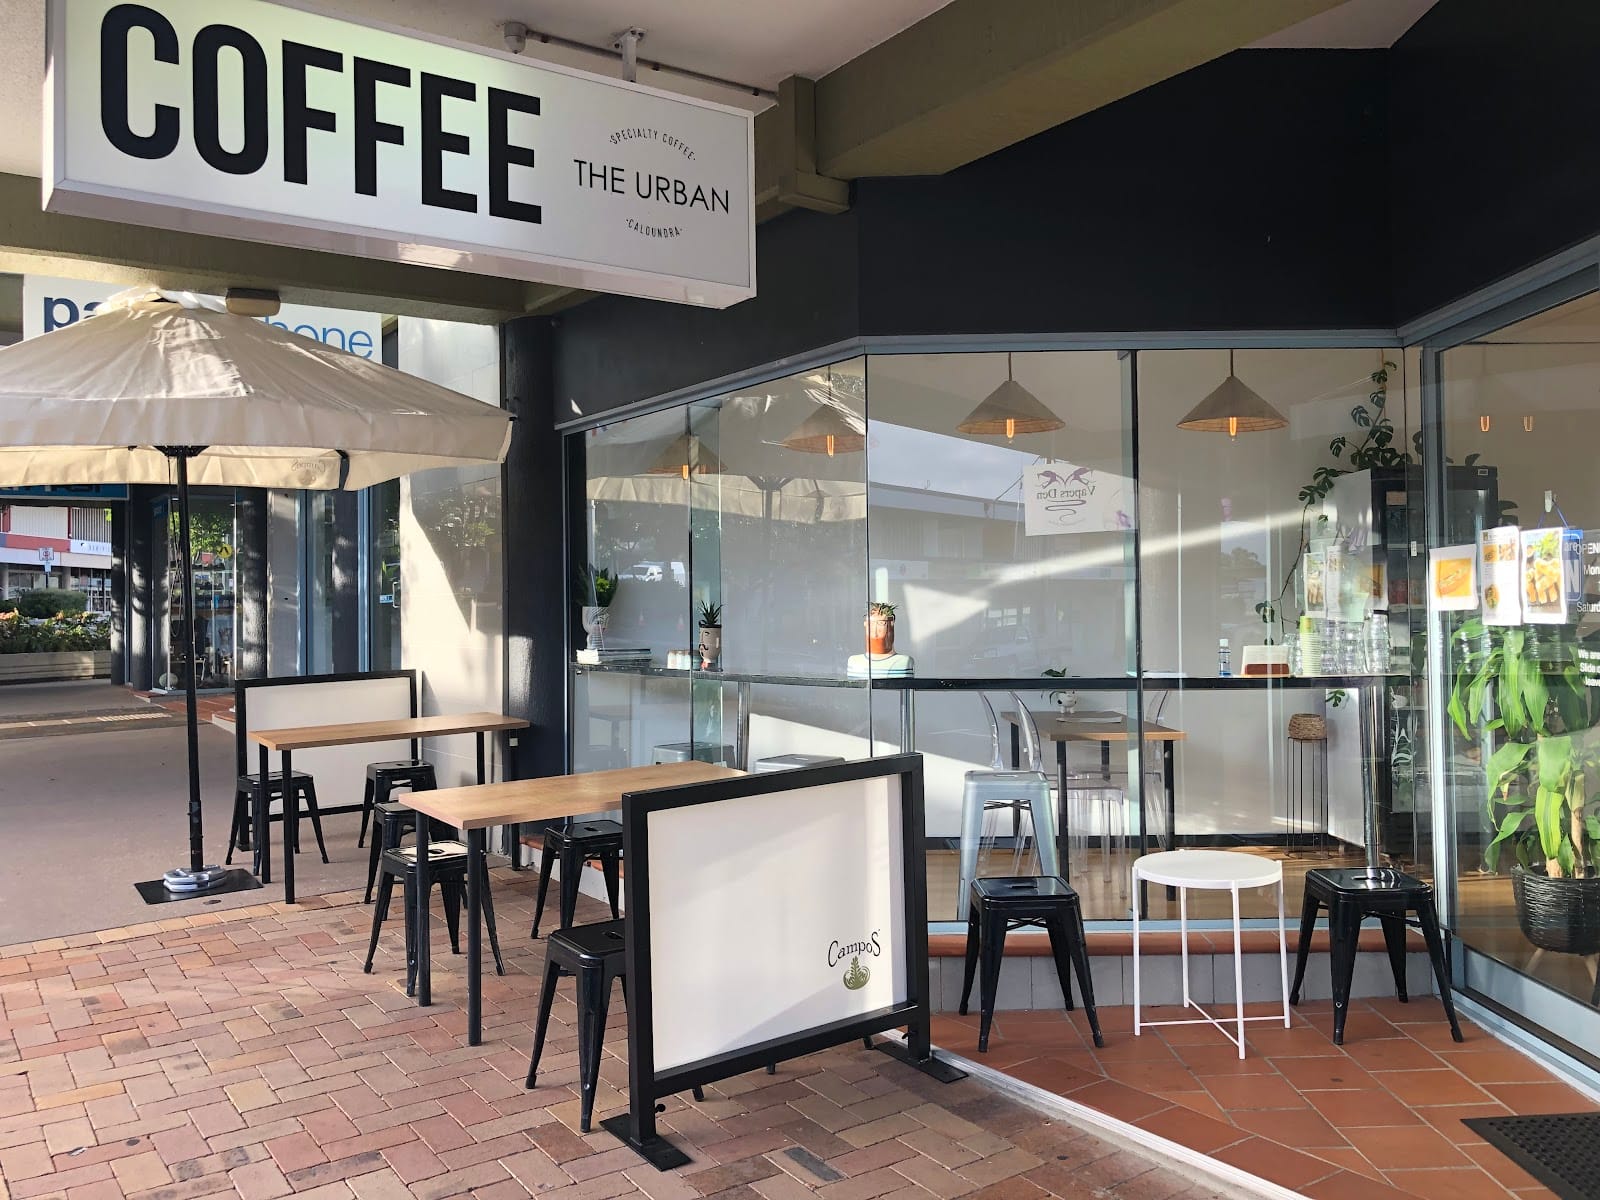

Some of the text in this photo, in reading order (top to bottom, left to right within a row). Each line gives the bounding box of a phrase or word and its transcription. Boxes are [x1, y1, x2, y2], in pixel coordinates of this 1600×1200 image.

[101, 3, 542, 225] COFFEE
[610, 128, 694, 161] SPECIALTY COFFEE
[573, 159, 729, 214] THE URBAN
[628, 218, 680, 238] CALOUNDRA
